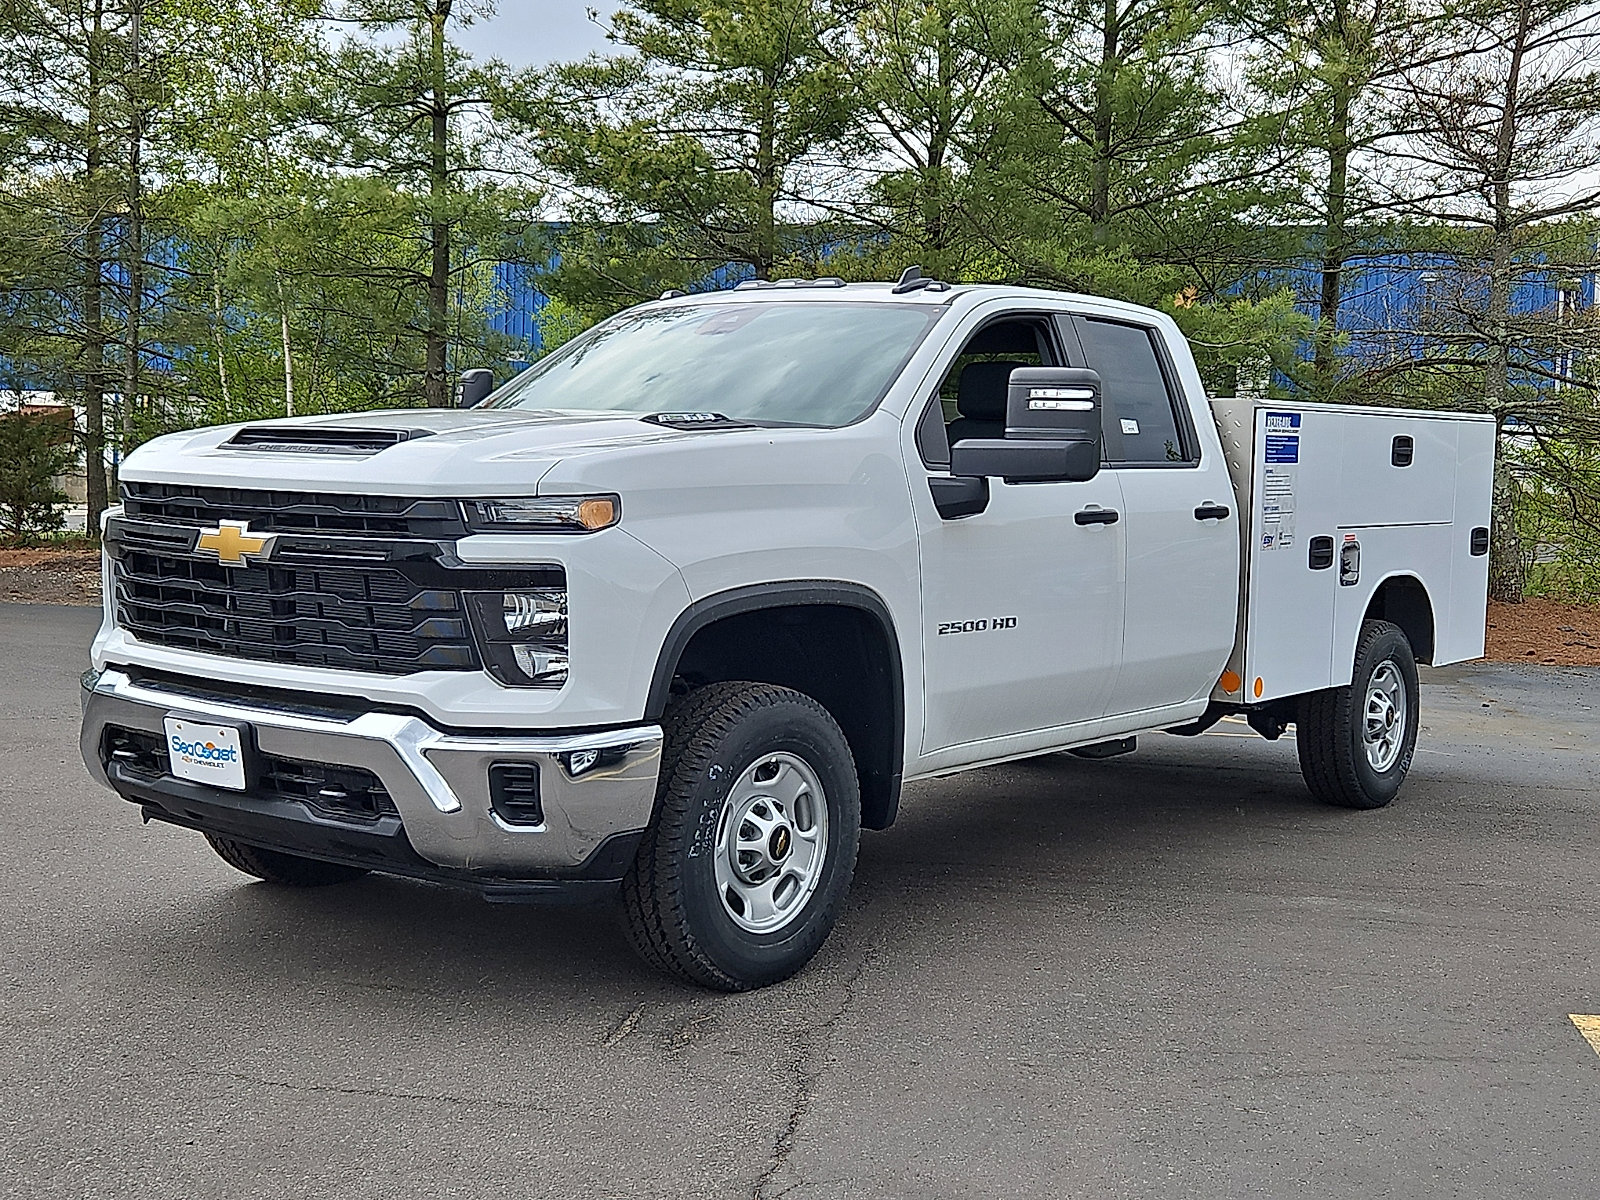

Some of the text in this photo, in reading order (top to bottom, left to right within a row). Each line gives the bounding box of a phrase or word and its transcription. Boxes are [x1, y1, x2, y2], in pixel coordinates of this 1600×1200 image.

[257, 444, 336, 453] CHEVROLET
[938, 617, 1017, 635] 2500 HD
[193, 758, 225, 769] CHEVROLET
